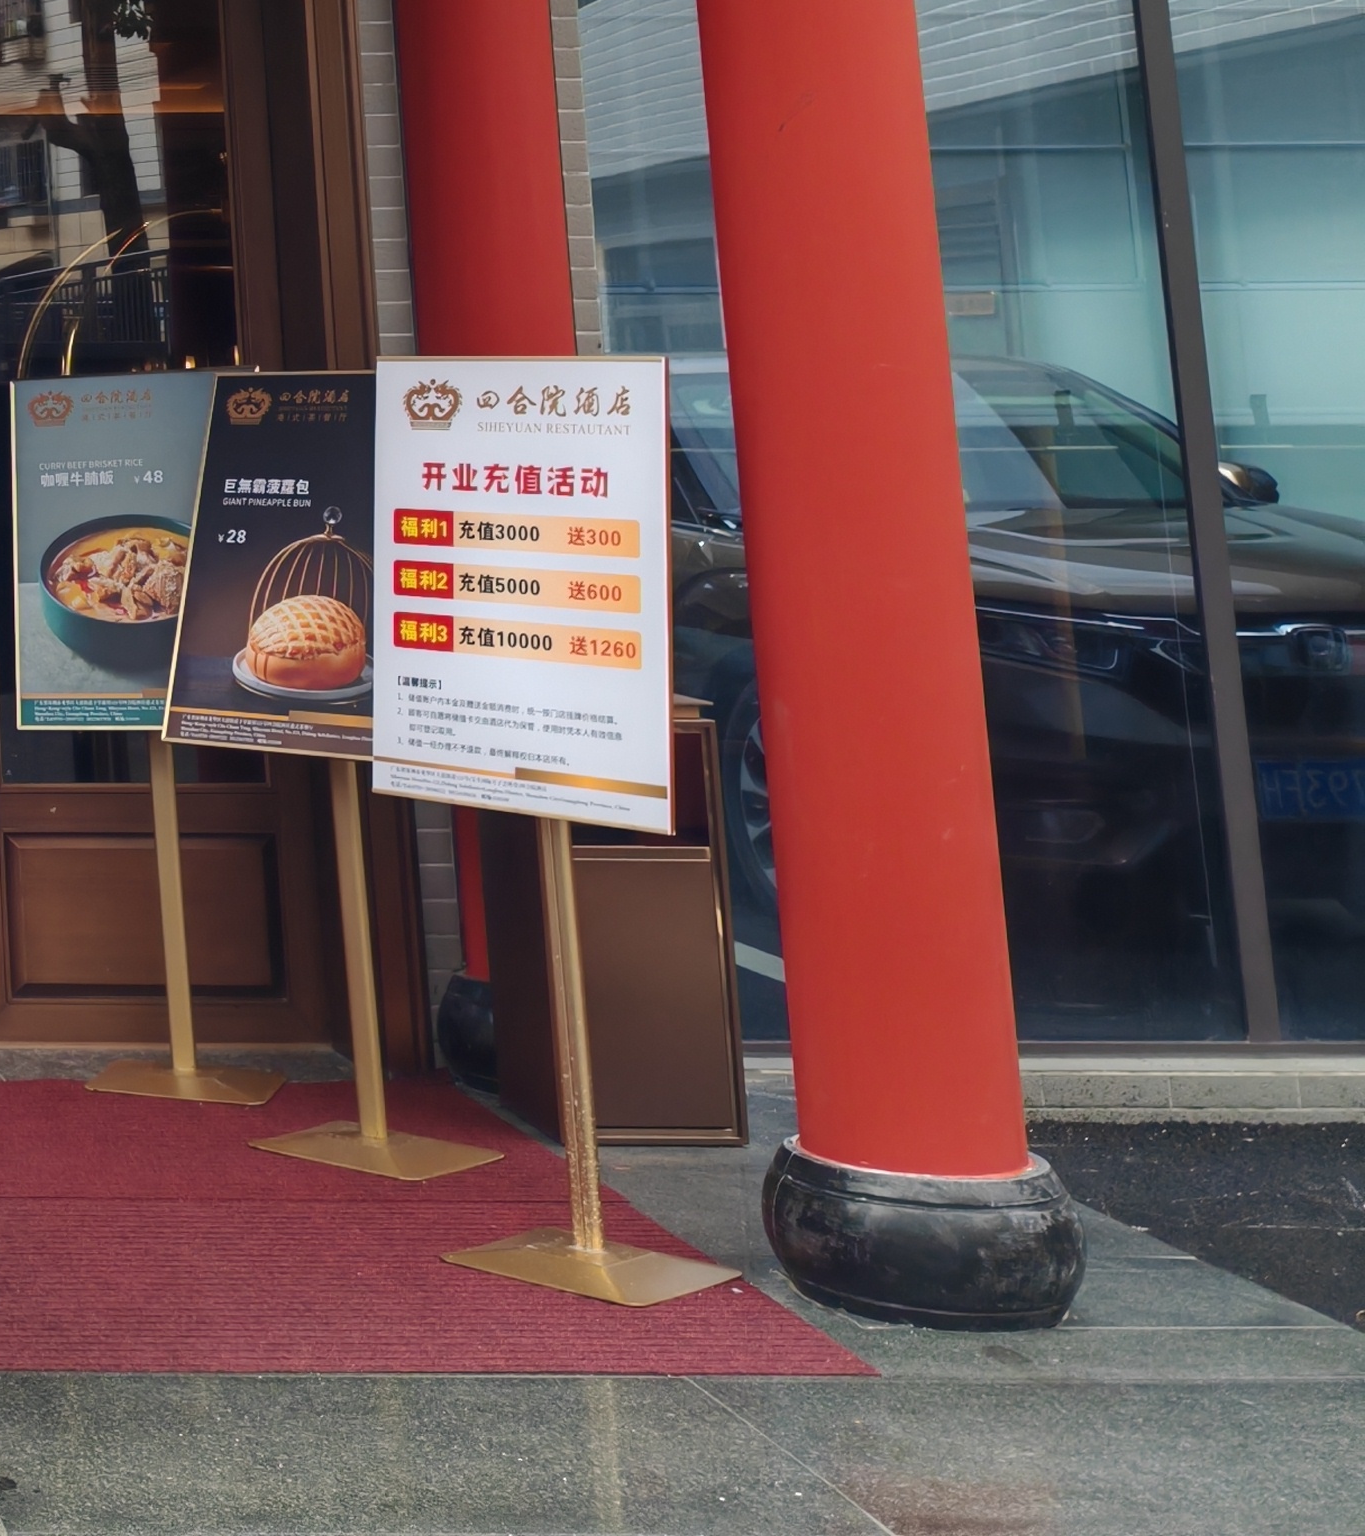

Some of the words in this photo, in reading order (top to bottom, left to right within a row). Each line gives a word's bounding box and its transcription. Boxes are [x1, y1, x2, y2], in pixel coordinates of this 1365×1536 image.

[476, 385, 632, 417] 四合院酒店
[477, 421, 542, 434] SIHEYUAN
[546, 423, 632, 436] RESTAUTANT
[39, 462, 66, 471] CURRY
[67, 460, 87, 469] BEEF
[89, 459, 122, 468] BRISKET
[125, 459, 143, 467] RICE
[421, 462, 609, 498] 开业充值活动
[224, 478, 310, 495] 巨無霸菠蘿包
[223, 497, 247, 506] GIANT
[248, 498, 292, 507] PINEAPPLE
[293, 498, 312, 508] BUN
[400, 516, 448, 539] 福利1
[459, 520, 540, 542] 充值3000
[567, 526, 622, 547] 送300
[400, 568, 448, 591] 福利2
[459, 572, 541, 596] 充值5000
[568, 581, 622, 602] 送600
[400, 619, 448, 644] 福利3
[459, 626, 553, 652] 充值10000
[569, 636, 636, 659] 送1260
